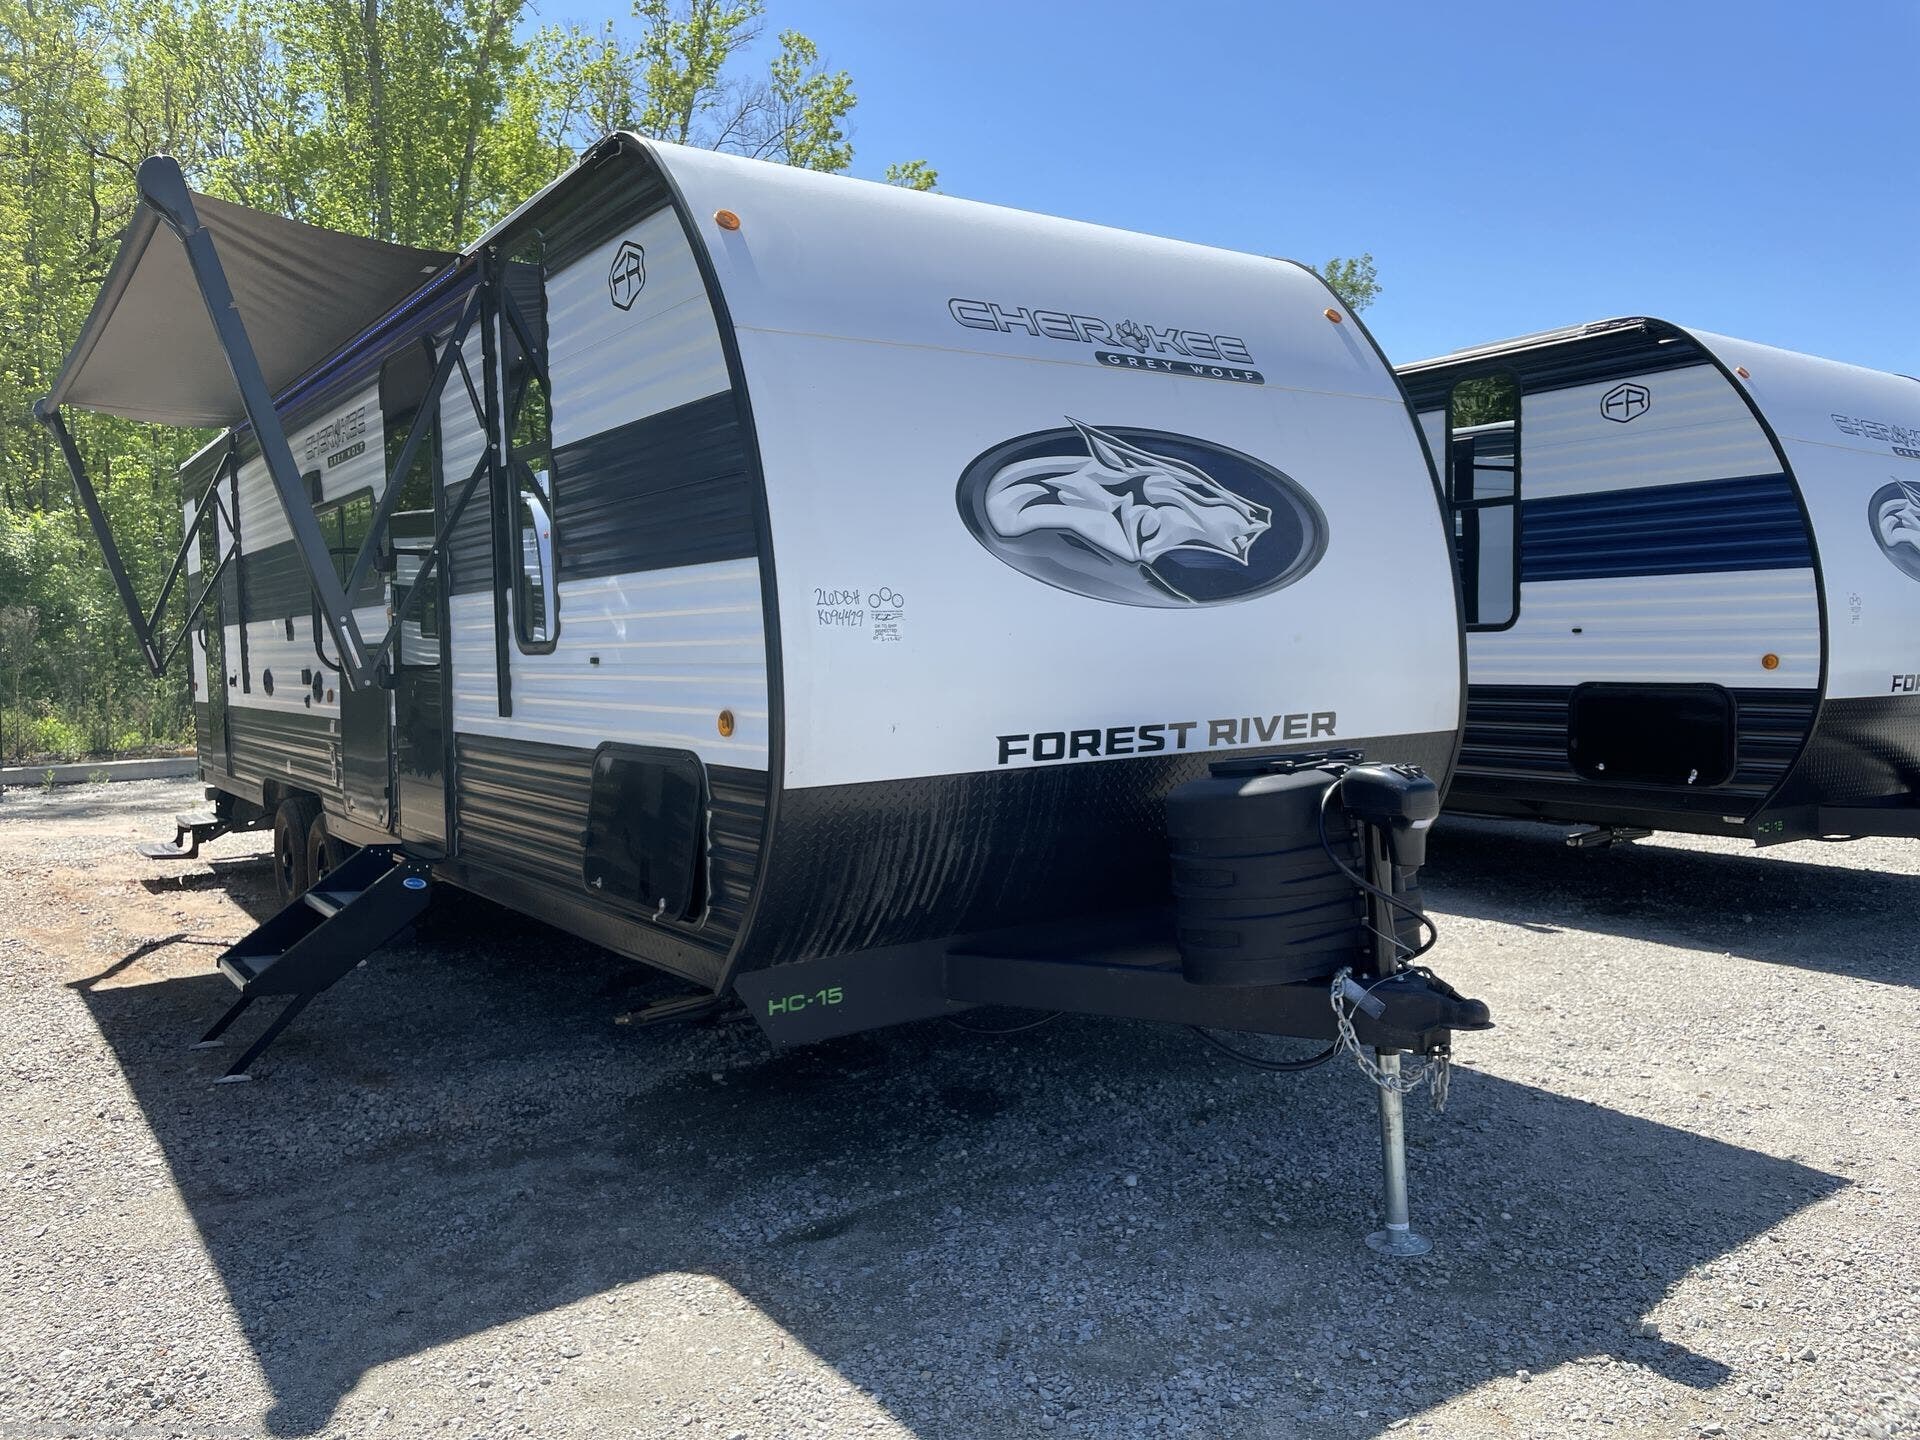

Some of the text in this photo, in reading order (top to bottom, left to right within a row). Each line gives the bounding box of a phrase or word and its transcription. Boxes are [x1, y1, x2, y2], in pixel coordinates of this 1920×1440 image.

[1106, 353, 1254, 381] GREY WOLF
[995, 711, 1337, 765] FOREST RIVER
[767, 987, 844, 1016] HC-15
